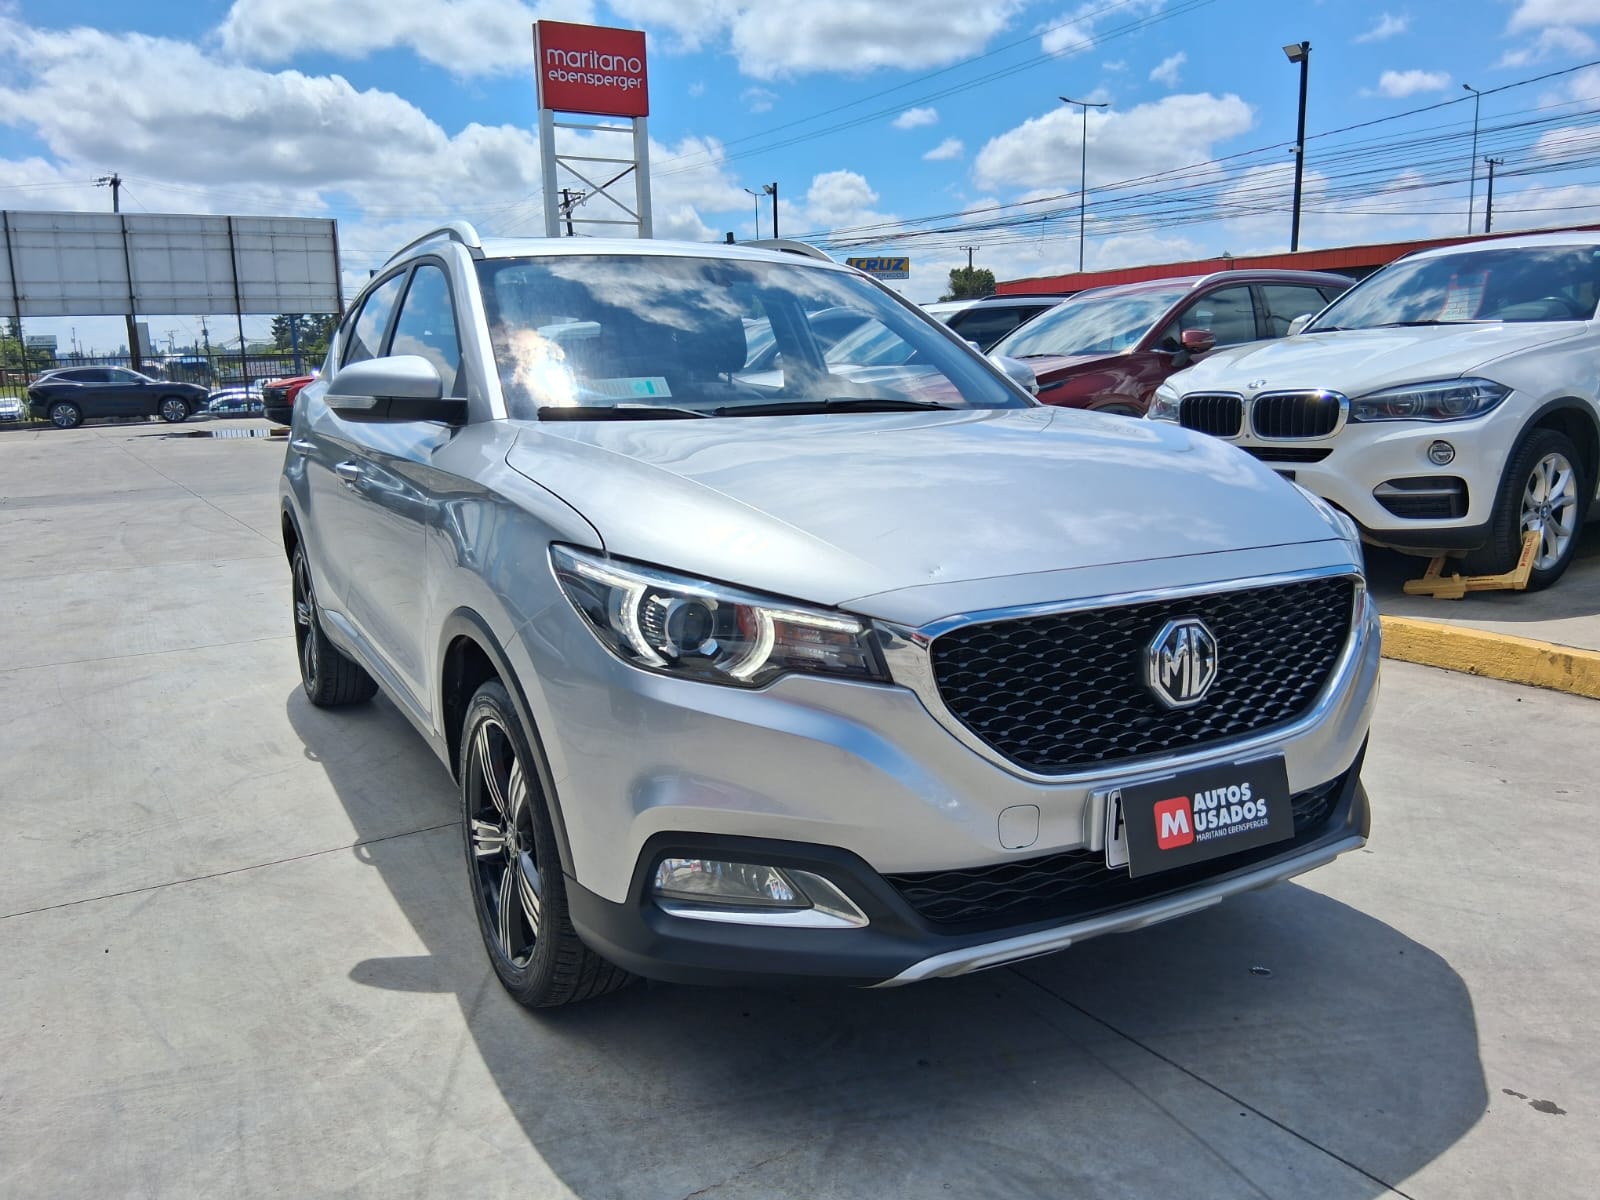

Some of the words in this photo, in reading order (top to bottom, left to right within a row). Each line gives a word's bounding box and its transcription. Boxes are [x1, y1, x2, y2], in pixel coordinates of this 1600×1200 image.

[546, 48, 642, 74] maritano
[548, 68, 643, 91] ebensperger
[855, 258, 905, 271] CRUZ
[1160, 625, 1214, 698] MG
[1193, 782, 1252, 812] AUTOS
[1161, 808, 1190, 839] M
[1194, 798, 1268, 831] USADOS
[1196, 827, 1228, 842] MARITANO
[1228, 818, 1269, 835] EBENSPERGER
